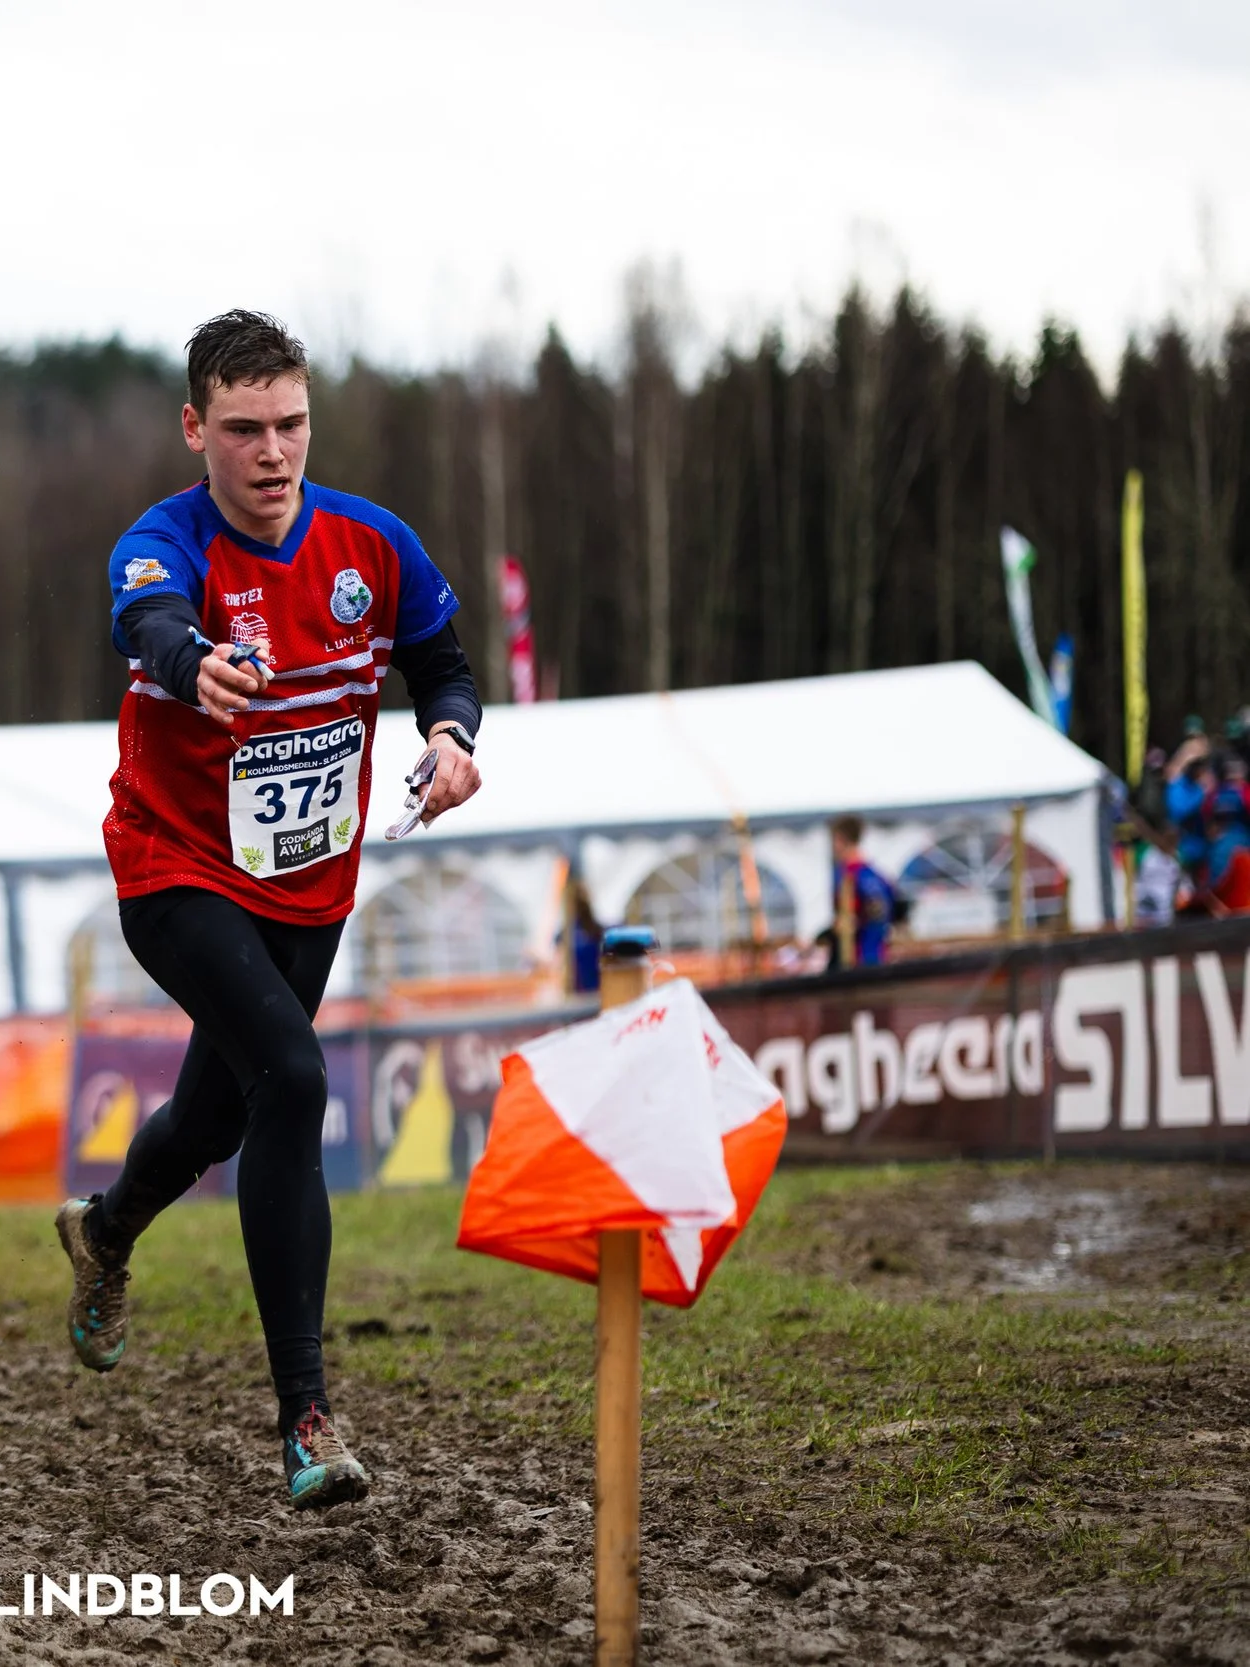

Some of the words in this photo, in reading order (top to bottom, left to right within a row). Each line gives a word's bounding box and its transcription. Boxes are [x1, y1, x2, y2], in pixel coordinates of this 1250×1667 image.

[247, 760, 318, 777] KOLMÅRDSMEDELN
[253, 764, 344, 825] 375
[279, 824, 325, 845] GODKÄNDA
[279, 833, 324, 857] AVLOPP
[753, 1010, 1045, 1134] agheera
